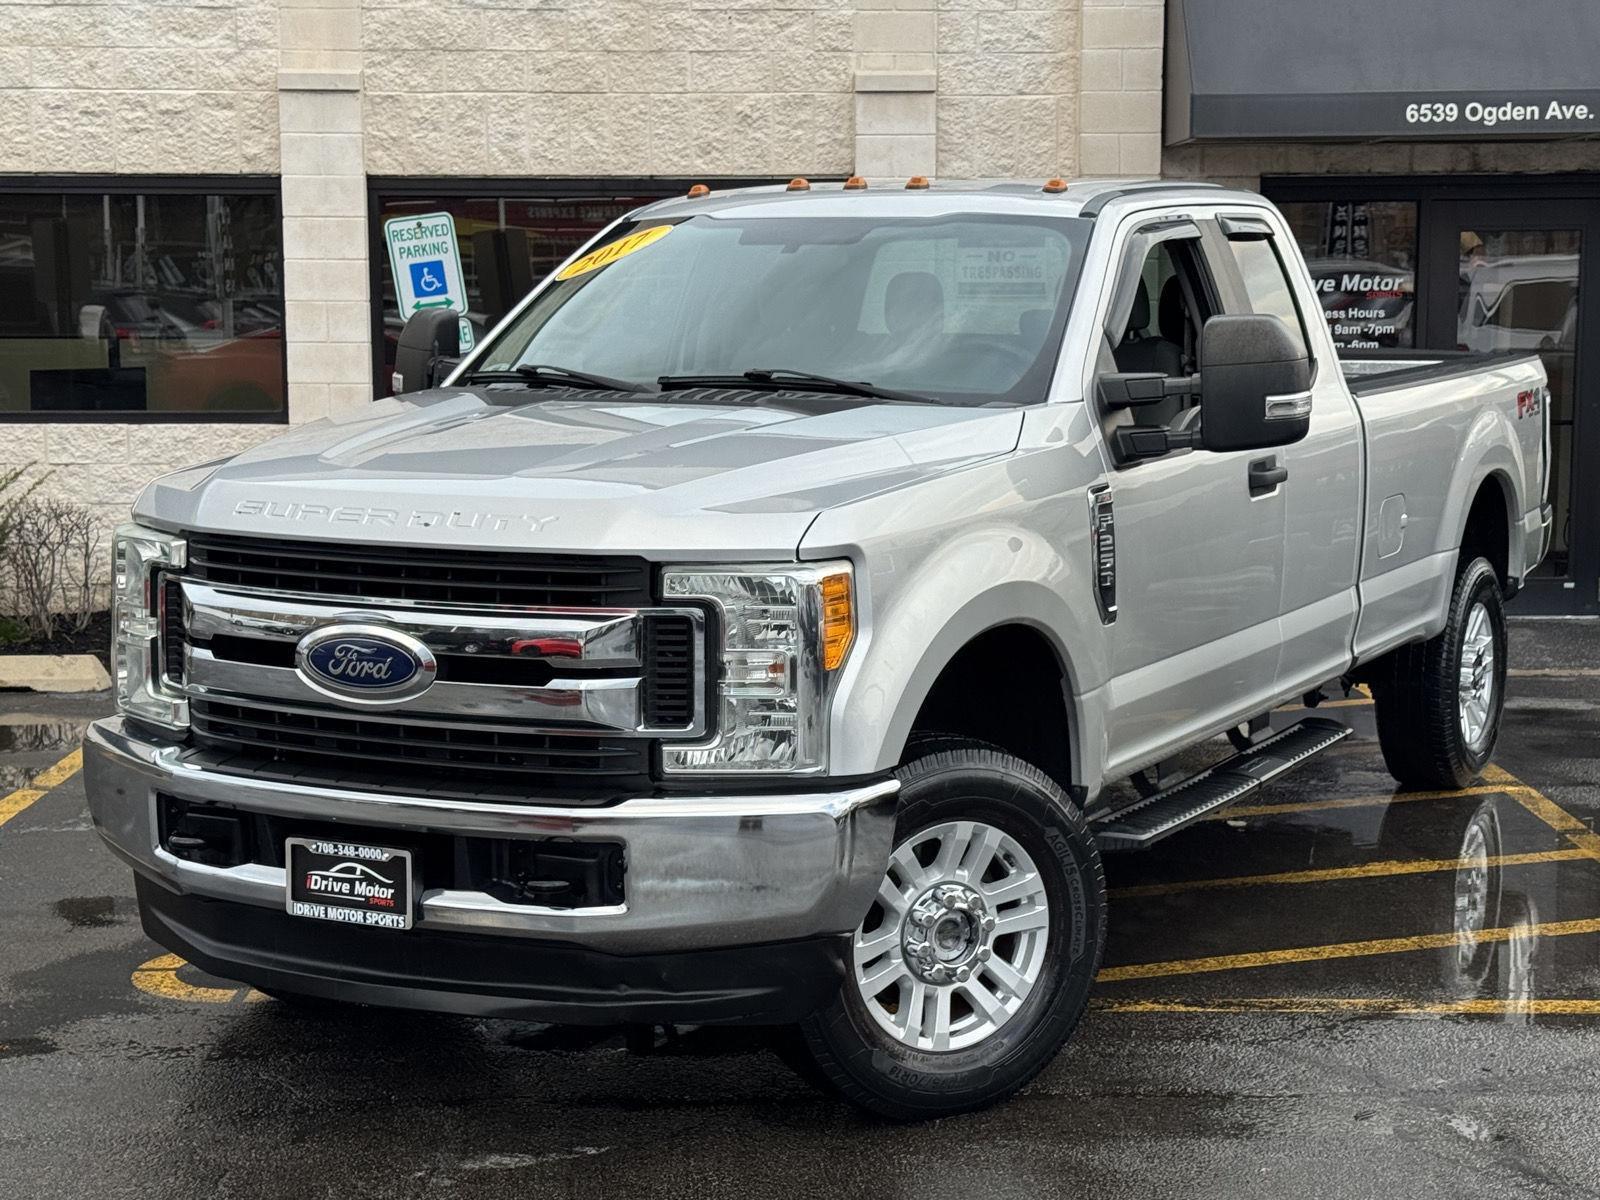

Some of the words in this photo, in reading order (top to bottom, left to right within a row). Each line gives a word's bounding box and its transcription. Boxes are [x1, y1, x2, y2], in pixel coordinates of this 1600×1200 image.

[1405, 103, 1458, 123] 6539
[1465, 102, 1539, 126] Ogden
[1545, 101, 1594, 120] Ave.
[391, 222, 449, 242] RESERVED
[399, 241, 449, 259] PARKING
[579, 233, 652, 271] 2017
[987, 250, 1016, 263] NO
[961, 264, 1042, 281] TRESPASSING
[1340, 274, 1404, 292] Motor
[1348, 307, 1386, 319] Hours
[1334, 323, 1361, 335] 9am
[233, 499, 401, 527] SUPER
[407, 509, 560, 534] DUTY
[327, 643, 393, 680] Ford
[317, 842, 382, 860] 708-348-0000
[305, 874, 351, 894] iDrive
[354, 881, 395, 899] Motor
[368, 897, 395, 908] SPORTS
[327, 906, 363, 922] MOTOR
[365, 913, 406, 928] SPORTS
